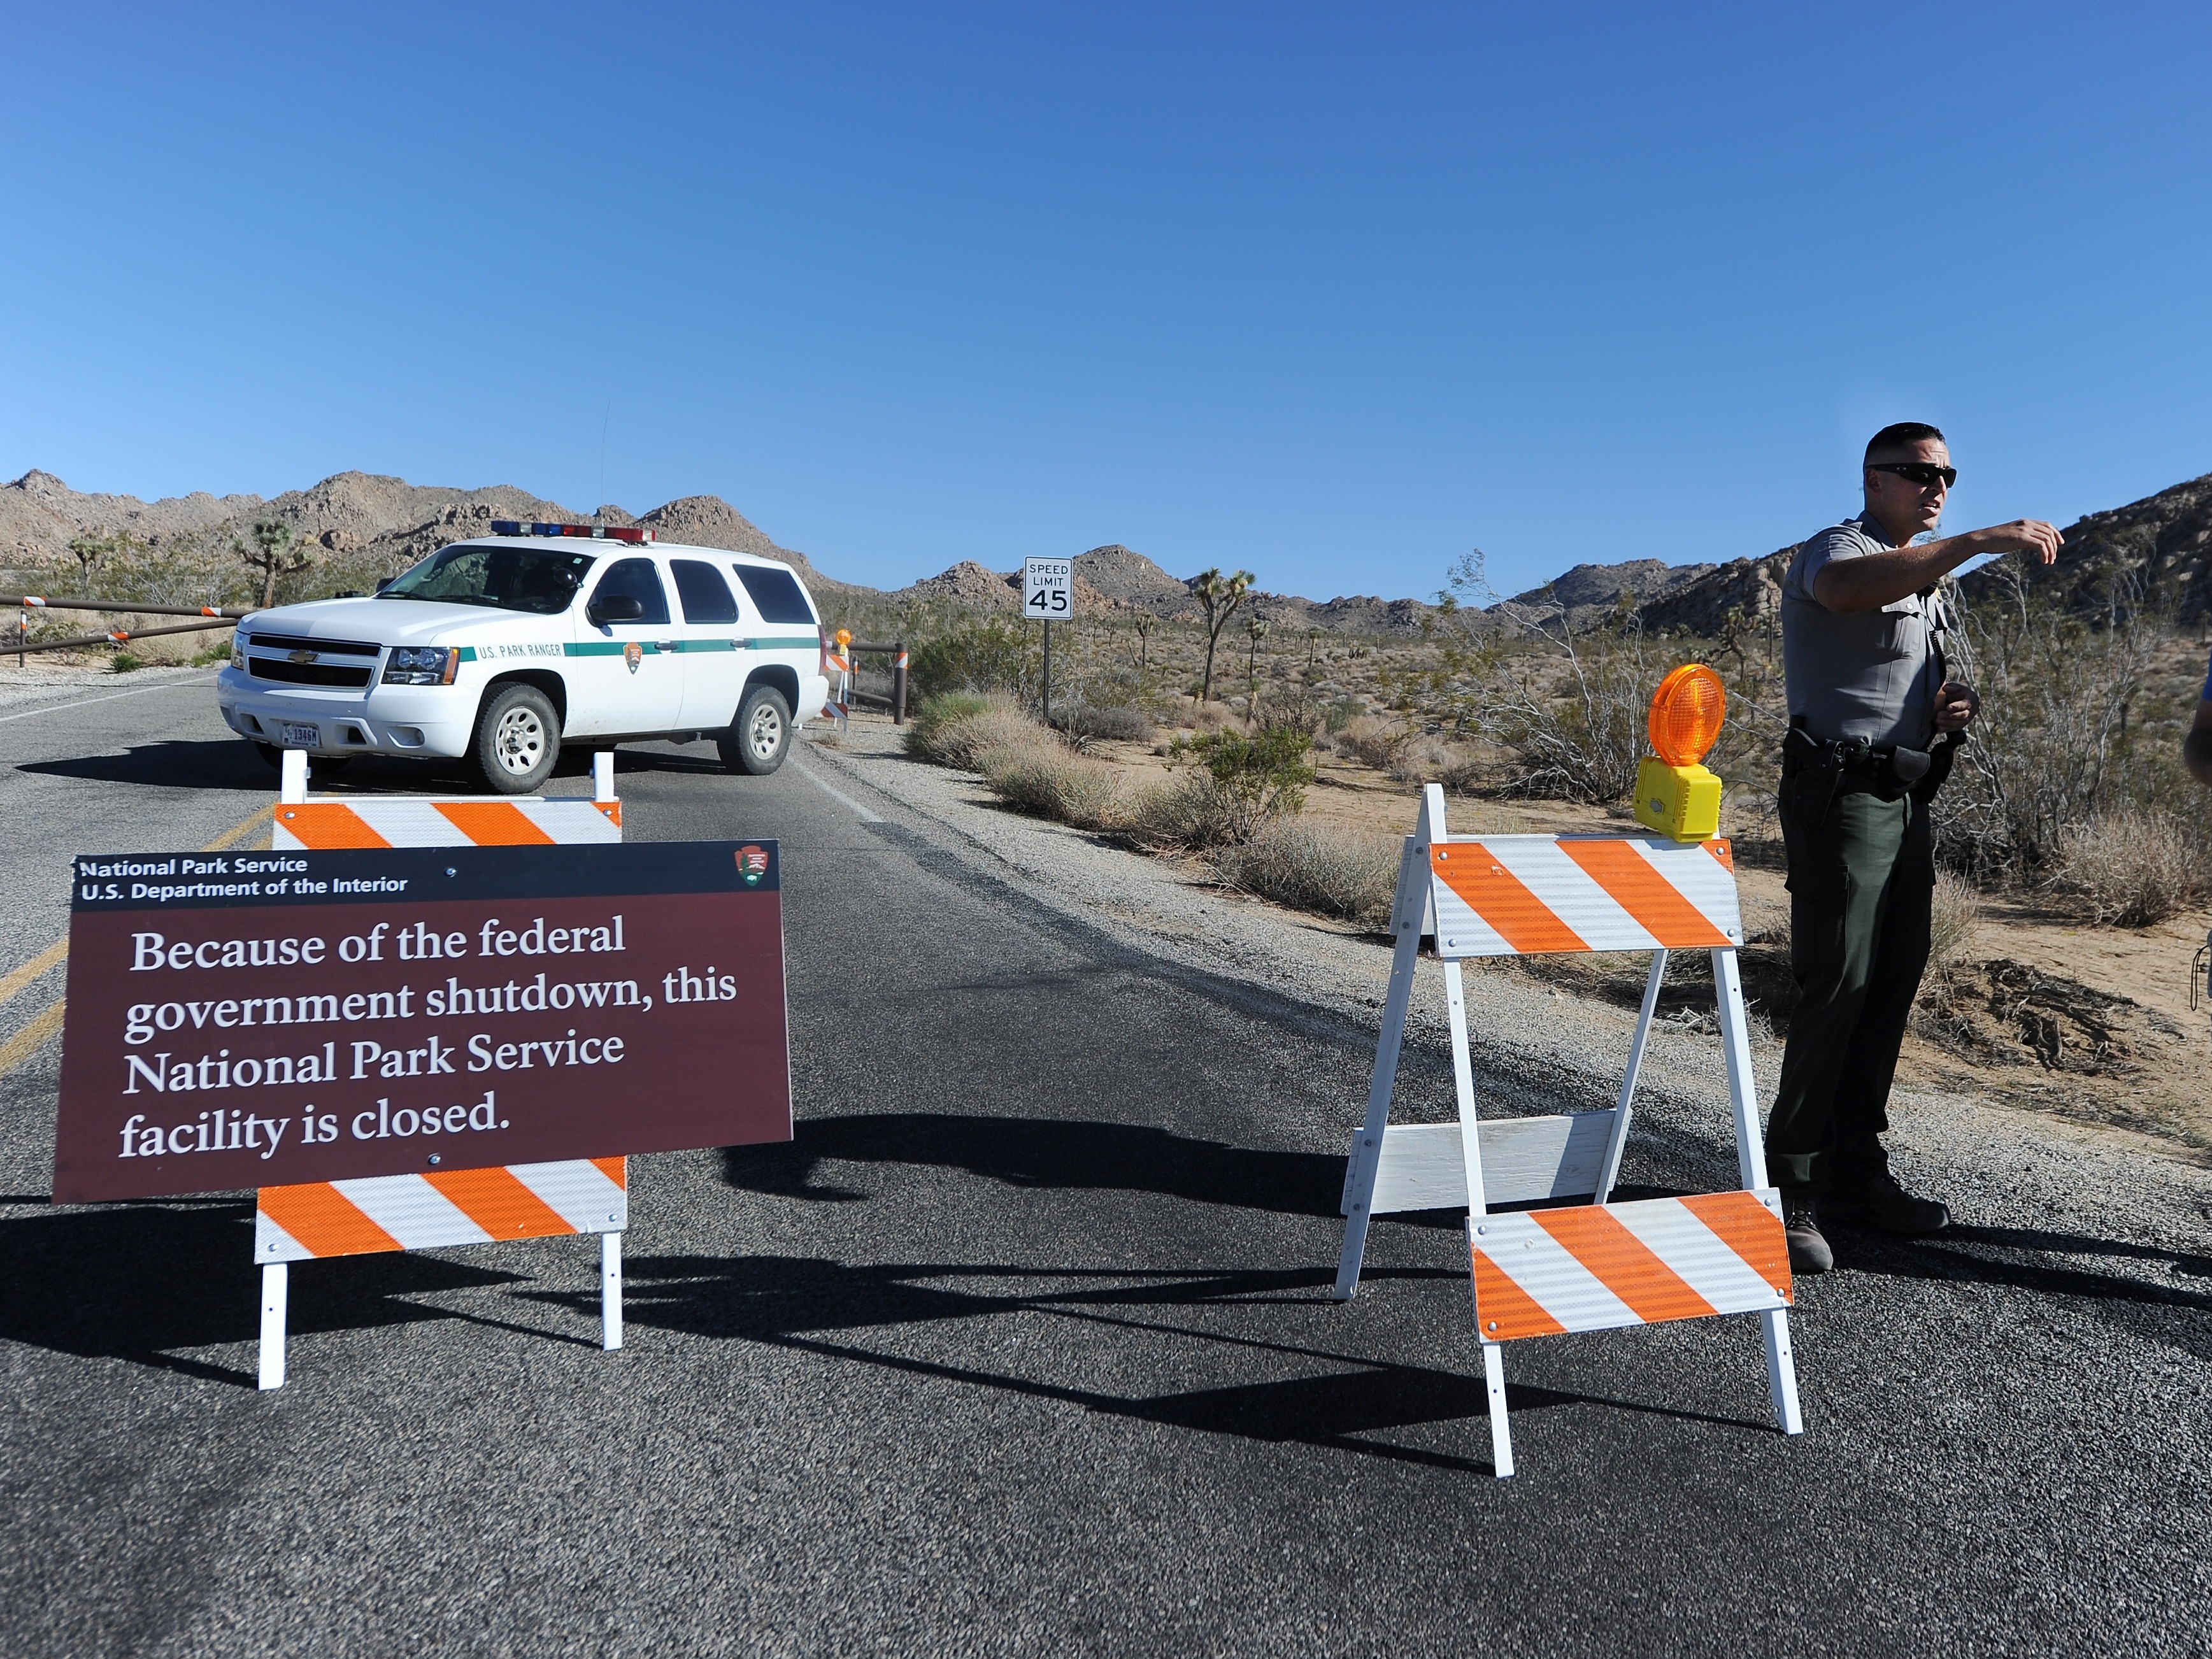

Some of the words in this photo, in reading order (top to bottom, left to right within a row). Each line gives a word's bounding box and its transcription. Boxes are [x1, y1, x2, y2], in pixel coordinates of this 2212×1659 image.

[1029, 564, 1068, 574] SPEED
[1033, 576, 1064, 587] LIMIT
[1029, 589, 1067, 611] 45
[479, 646, 497, 659] U.S.
[499, 644, 526, 657] PARK
[527, 644, 561, 657] RANGER
[79, 858, 176, 877] National
[182, 857, 229, 874] Park
[234, 857, 308, 874] Service
[82, 883, 124, 901] U.S.
[131, 881, 260, 902] Department
[264, 878, 289, 895] of
[292, 878, 328, 894] the
[333, 876, 408, 893] Interior
[129, 932, 325, 971] Because
[338, 922, 390, 962] of
[396, 921, 467, 960] the
[478, 915, 626, 957] federal
[124, 985, 415, 1045] government
[426, 972, 653, 1016] shutdown,
[662, 965, 737, 1004] this
[122, 1041, 338, 1095] National
[349, 1036, 456, 1079] Park
[467, 1029, 625, 1072] Service
[118, 1109, 291, 1160] facility
[301, 1104, 339, 1144] is
[352, 1090, 510, 1140] closed.
